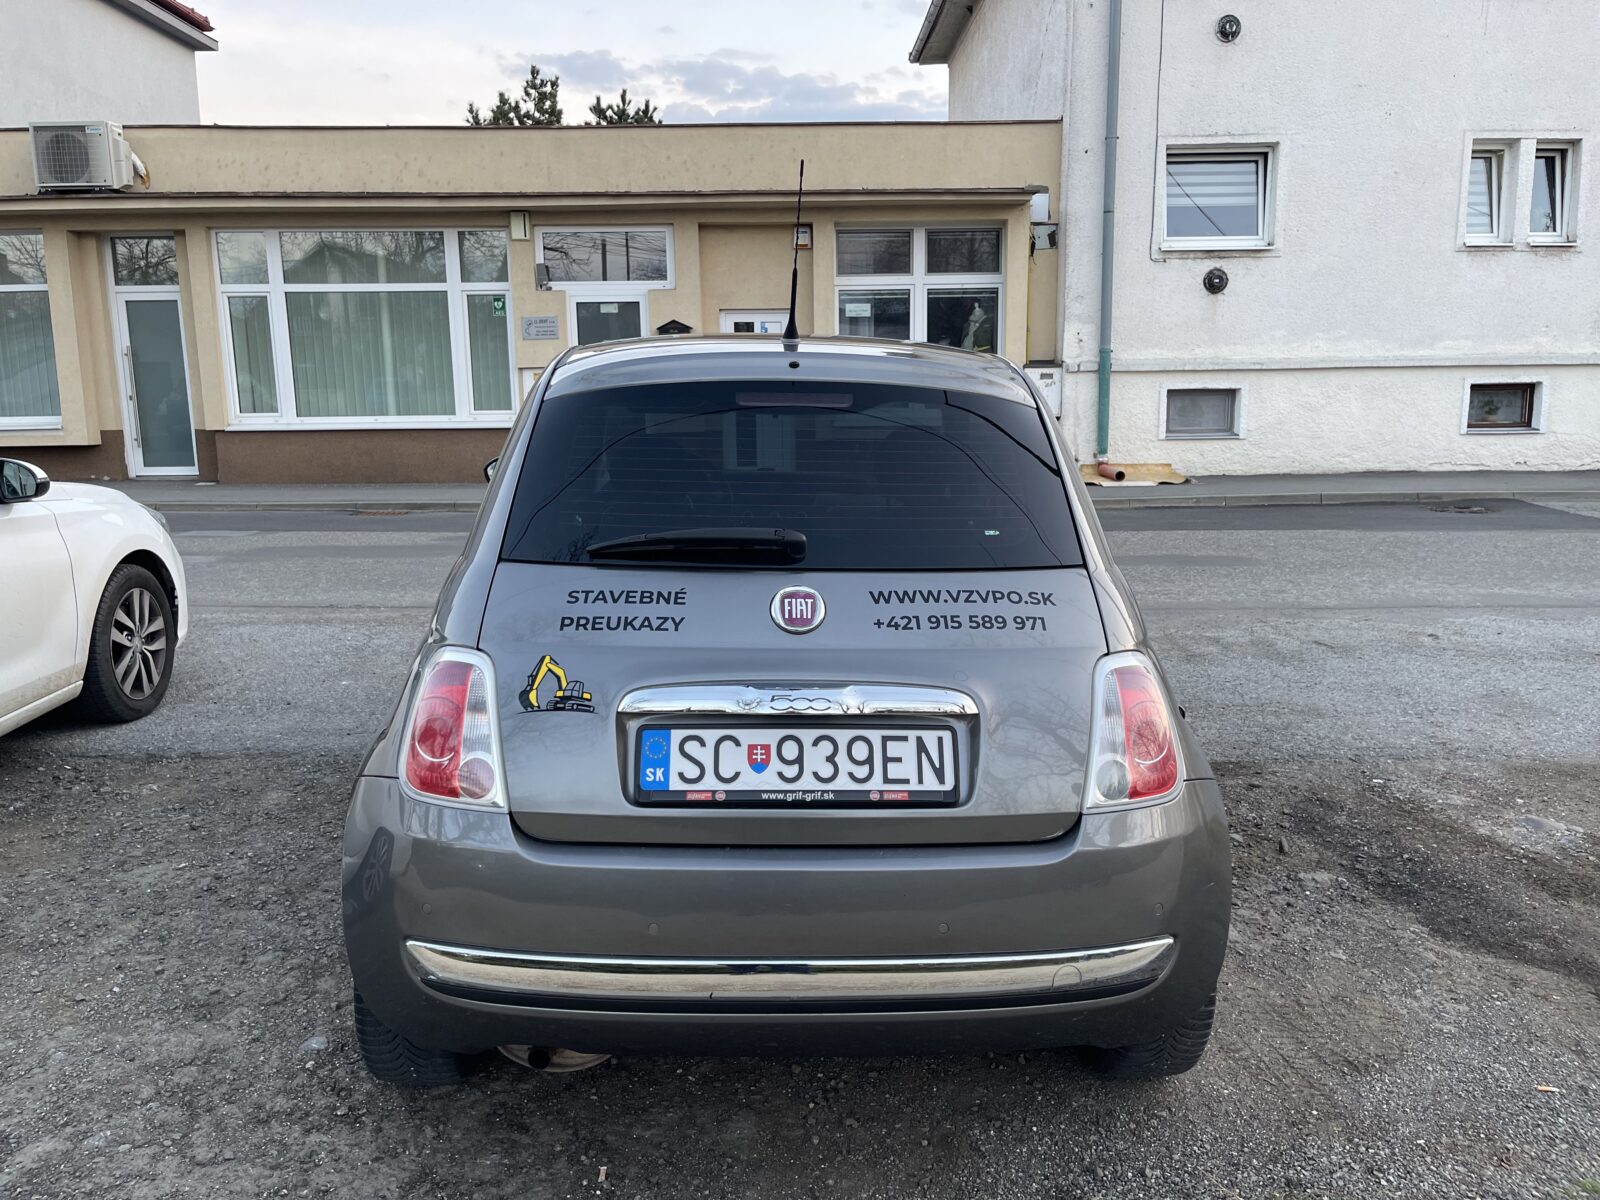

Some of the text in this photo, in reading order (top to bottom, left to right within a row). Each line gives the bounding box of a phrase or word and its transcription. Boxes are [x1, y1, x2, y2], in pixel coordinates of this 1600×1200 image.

[566, 587, 688, 605] STAVEBNÉ
[869, 589, 1057, 607] WWW.VZVPO.SK
[784, 598, 814, 619] FIAT
[559, 616, 686, 632] PREUKAZY
[873, 614, 1047, 631] +421 915 589 971
[769, 694, 832, 711] 500
[677, 734, 946, 785] SC 939EN
[645, 767, 665, 782] SK
[760, 791, 835, 802] www.grif-grif.sk
